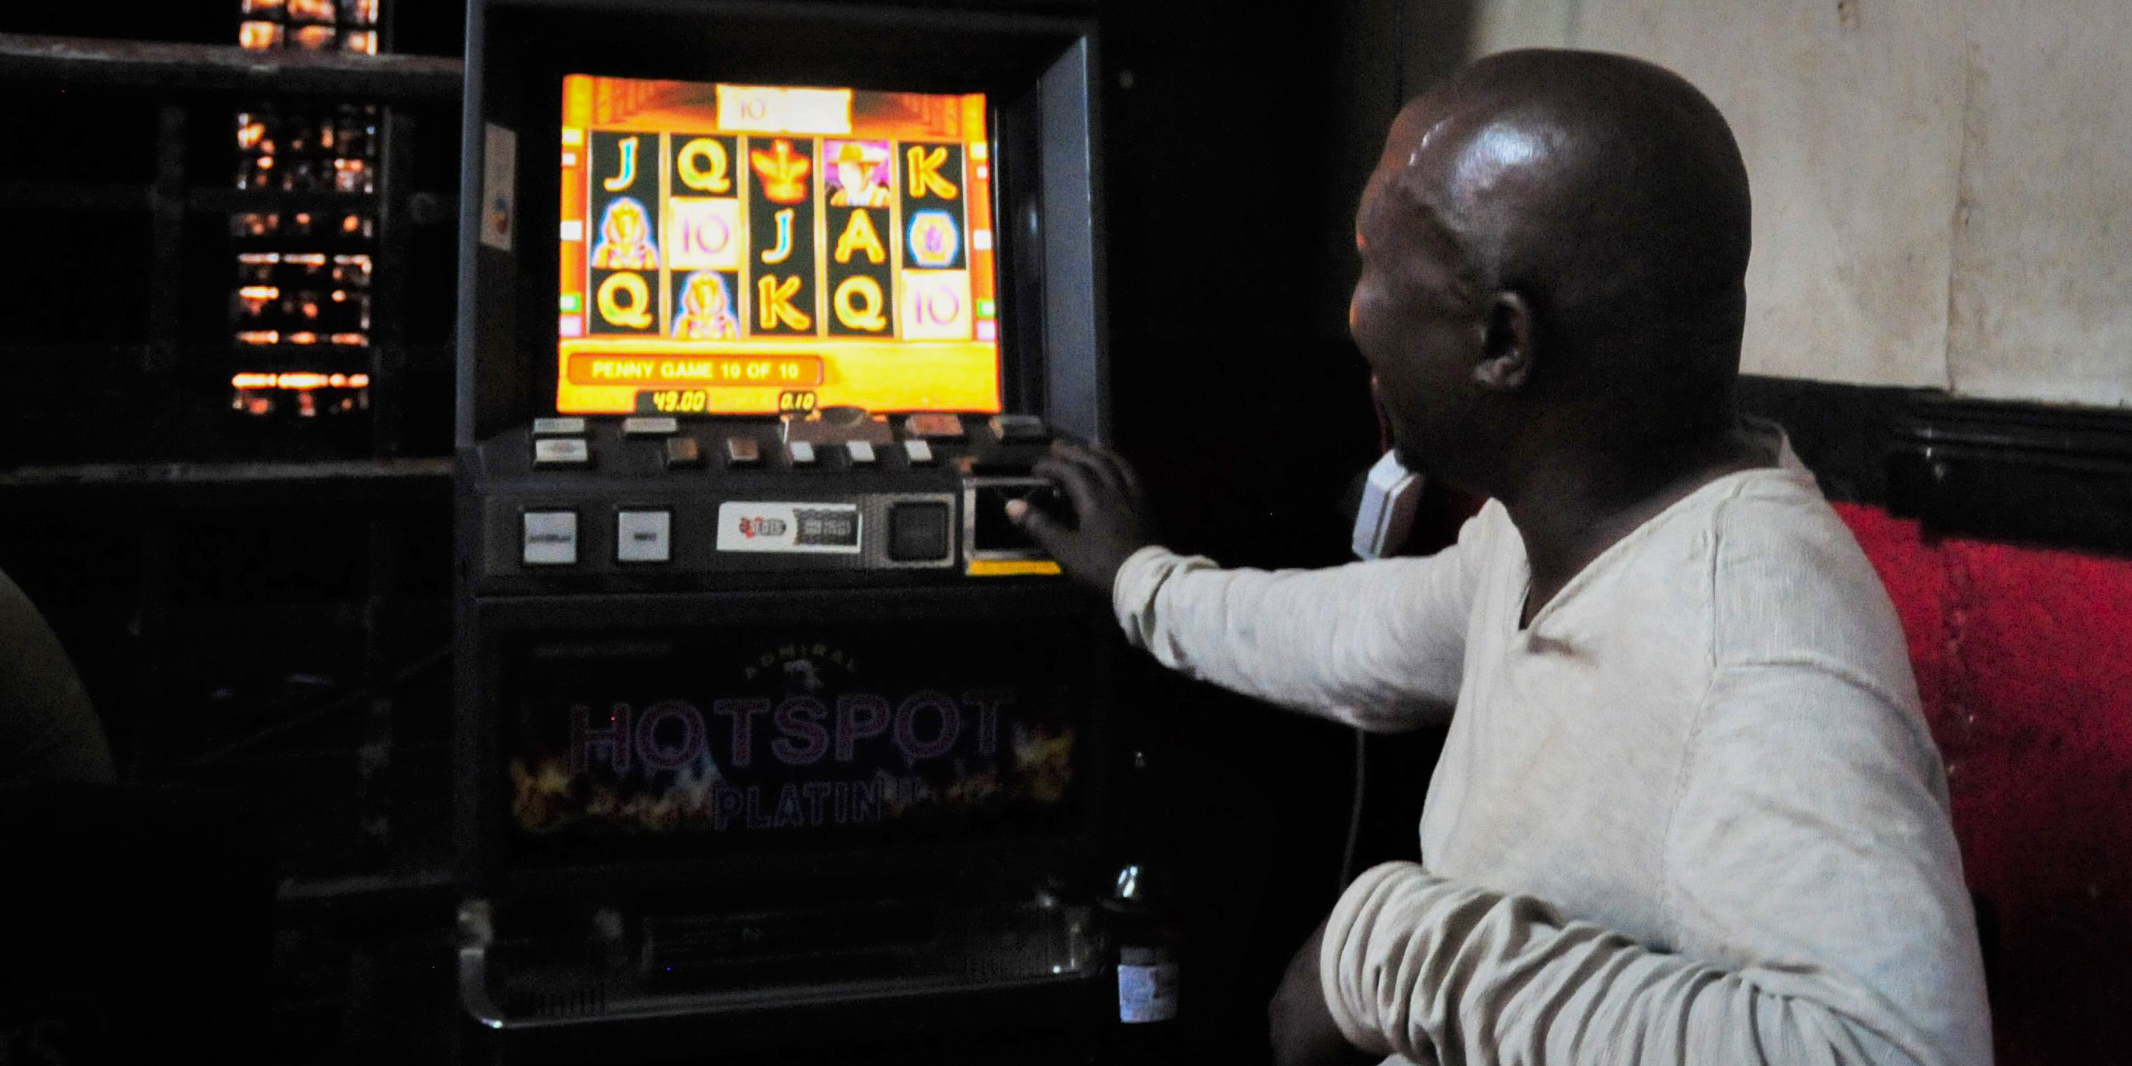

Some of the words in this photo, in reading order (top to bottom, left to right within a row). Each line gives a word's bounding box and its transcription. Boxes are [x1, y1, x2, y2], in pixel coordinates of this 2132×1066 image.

[740, 95, 767, 120] 10
[603, 136, 638, 192] J
[677, 138, 731, 193] Q
[907, 145, 958, 200] K
[682, 214, 730, 256] 10
[761, 208, 795, 265] J
[834, 208, 886, 265] A
[597, 271, 653, 329] Q
[757, 274, 811, 331] K
[832, 275, 887, 332] Q
[914, 286, 961, 325] 10
[592, 361, 654, 379] PENNY
[661, 361, 713, 380] GAME
[720, 361, 741, 380] 10
[747, 361, 769, 380] OF
[780, 361, 799, 380] 10
[653, 391, 706, 412] 49.00
[780, 392, 814, 411] 0.10
[567, 688, 1017, 774] HOTSPOT
